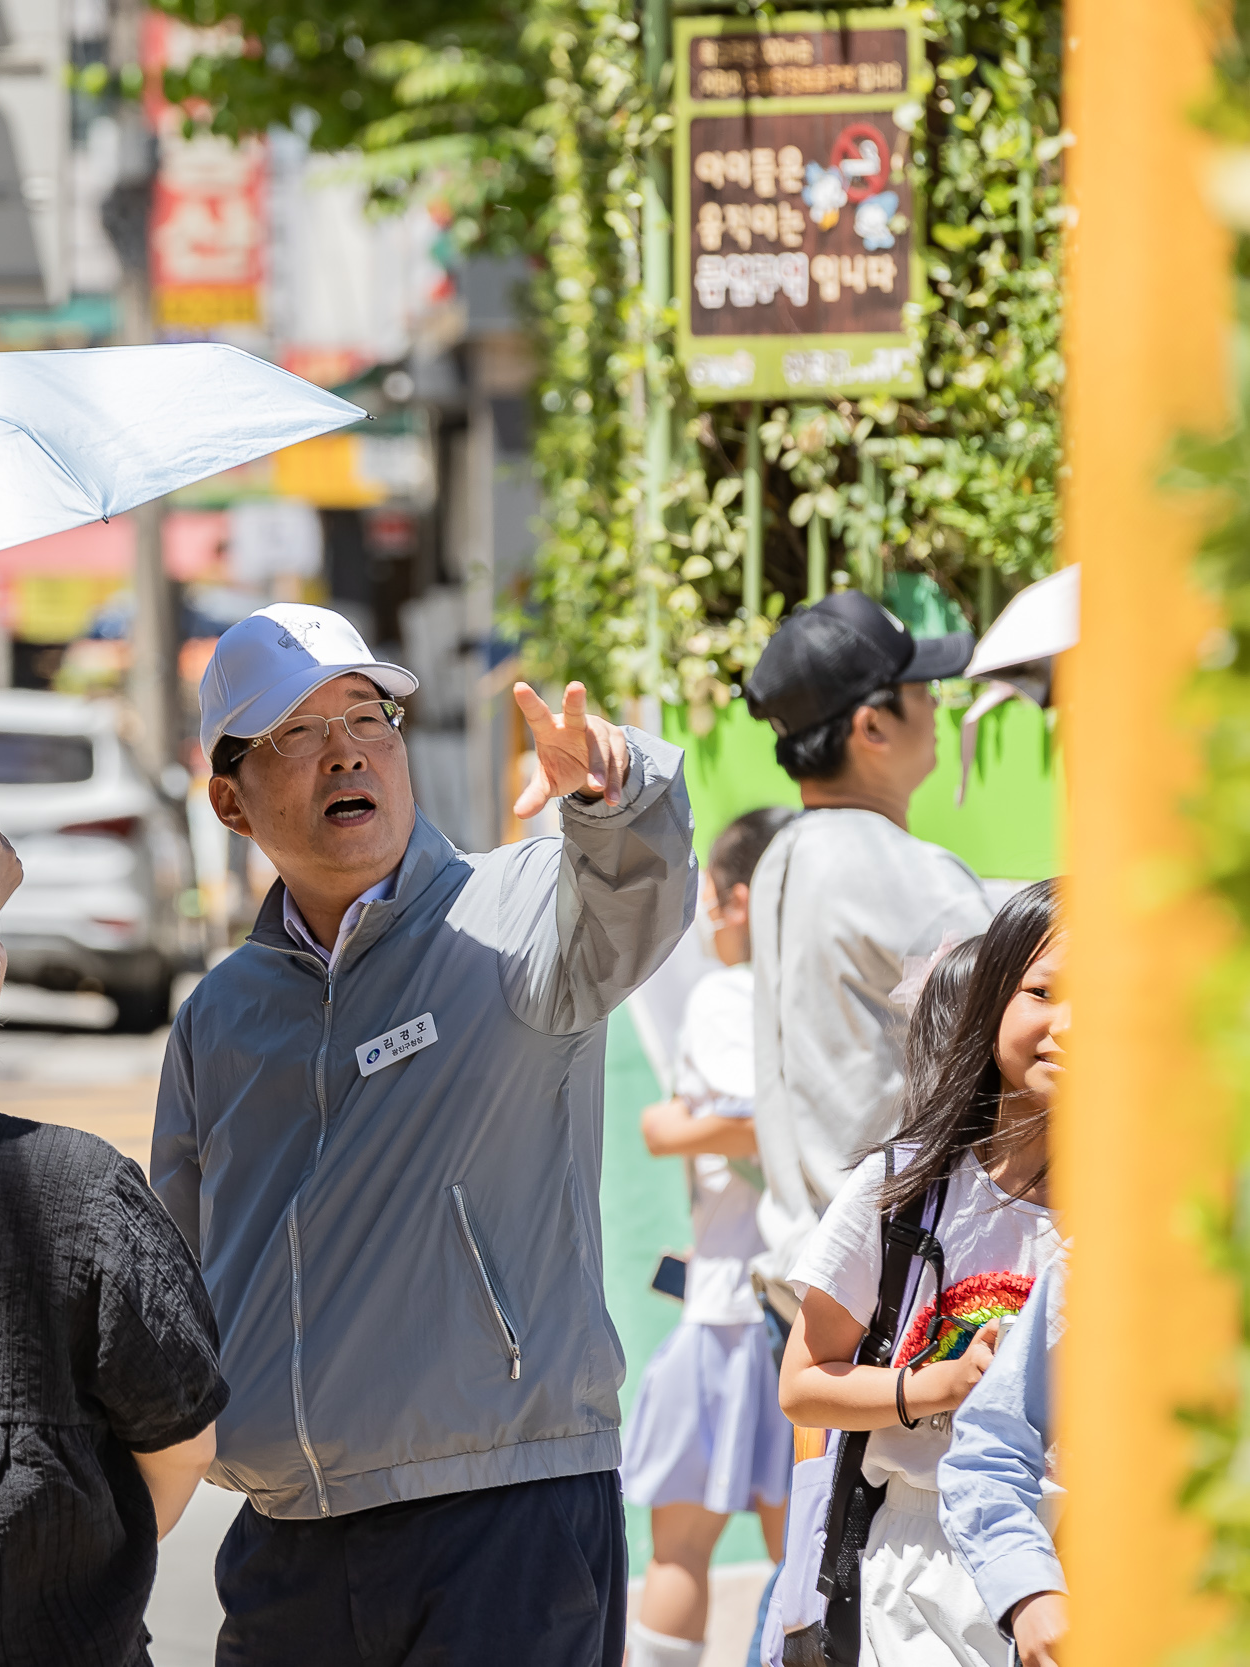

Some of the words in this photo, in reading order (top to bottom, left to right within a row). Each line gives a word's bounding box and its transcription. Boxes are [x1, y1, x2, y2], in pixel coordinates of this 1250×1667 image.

[694, 145, 804, 198] 아이들은
[695, 201, 806, 251] 움직이는
[810, 253, 898, 302] 입니다
[391, 1036, 424, 1057] 광진구청장
